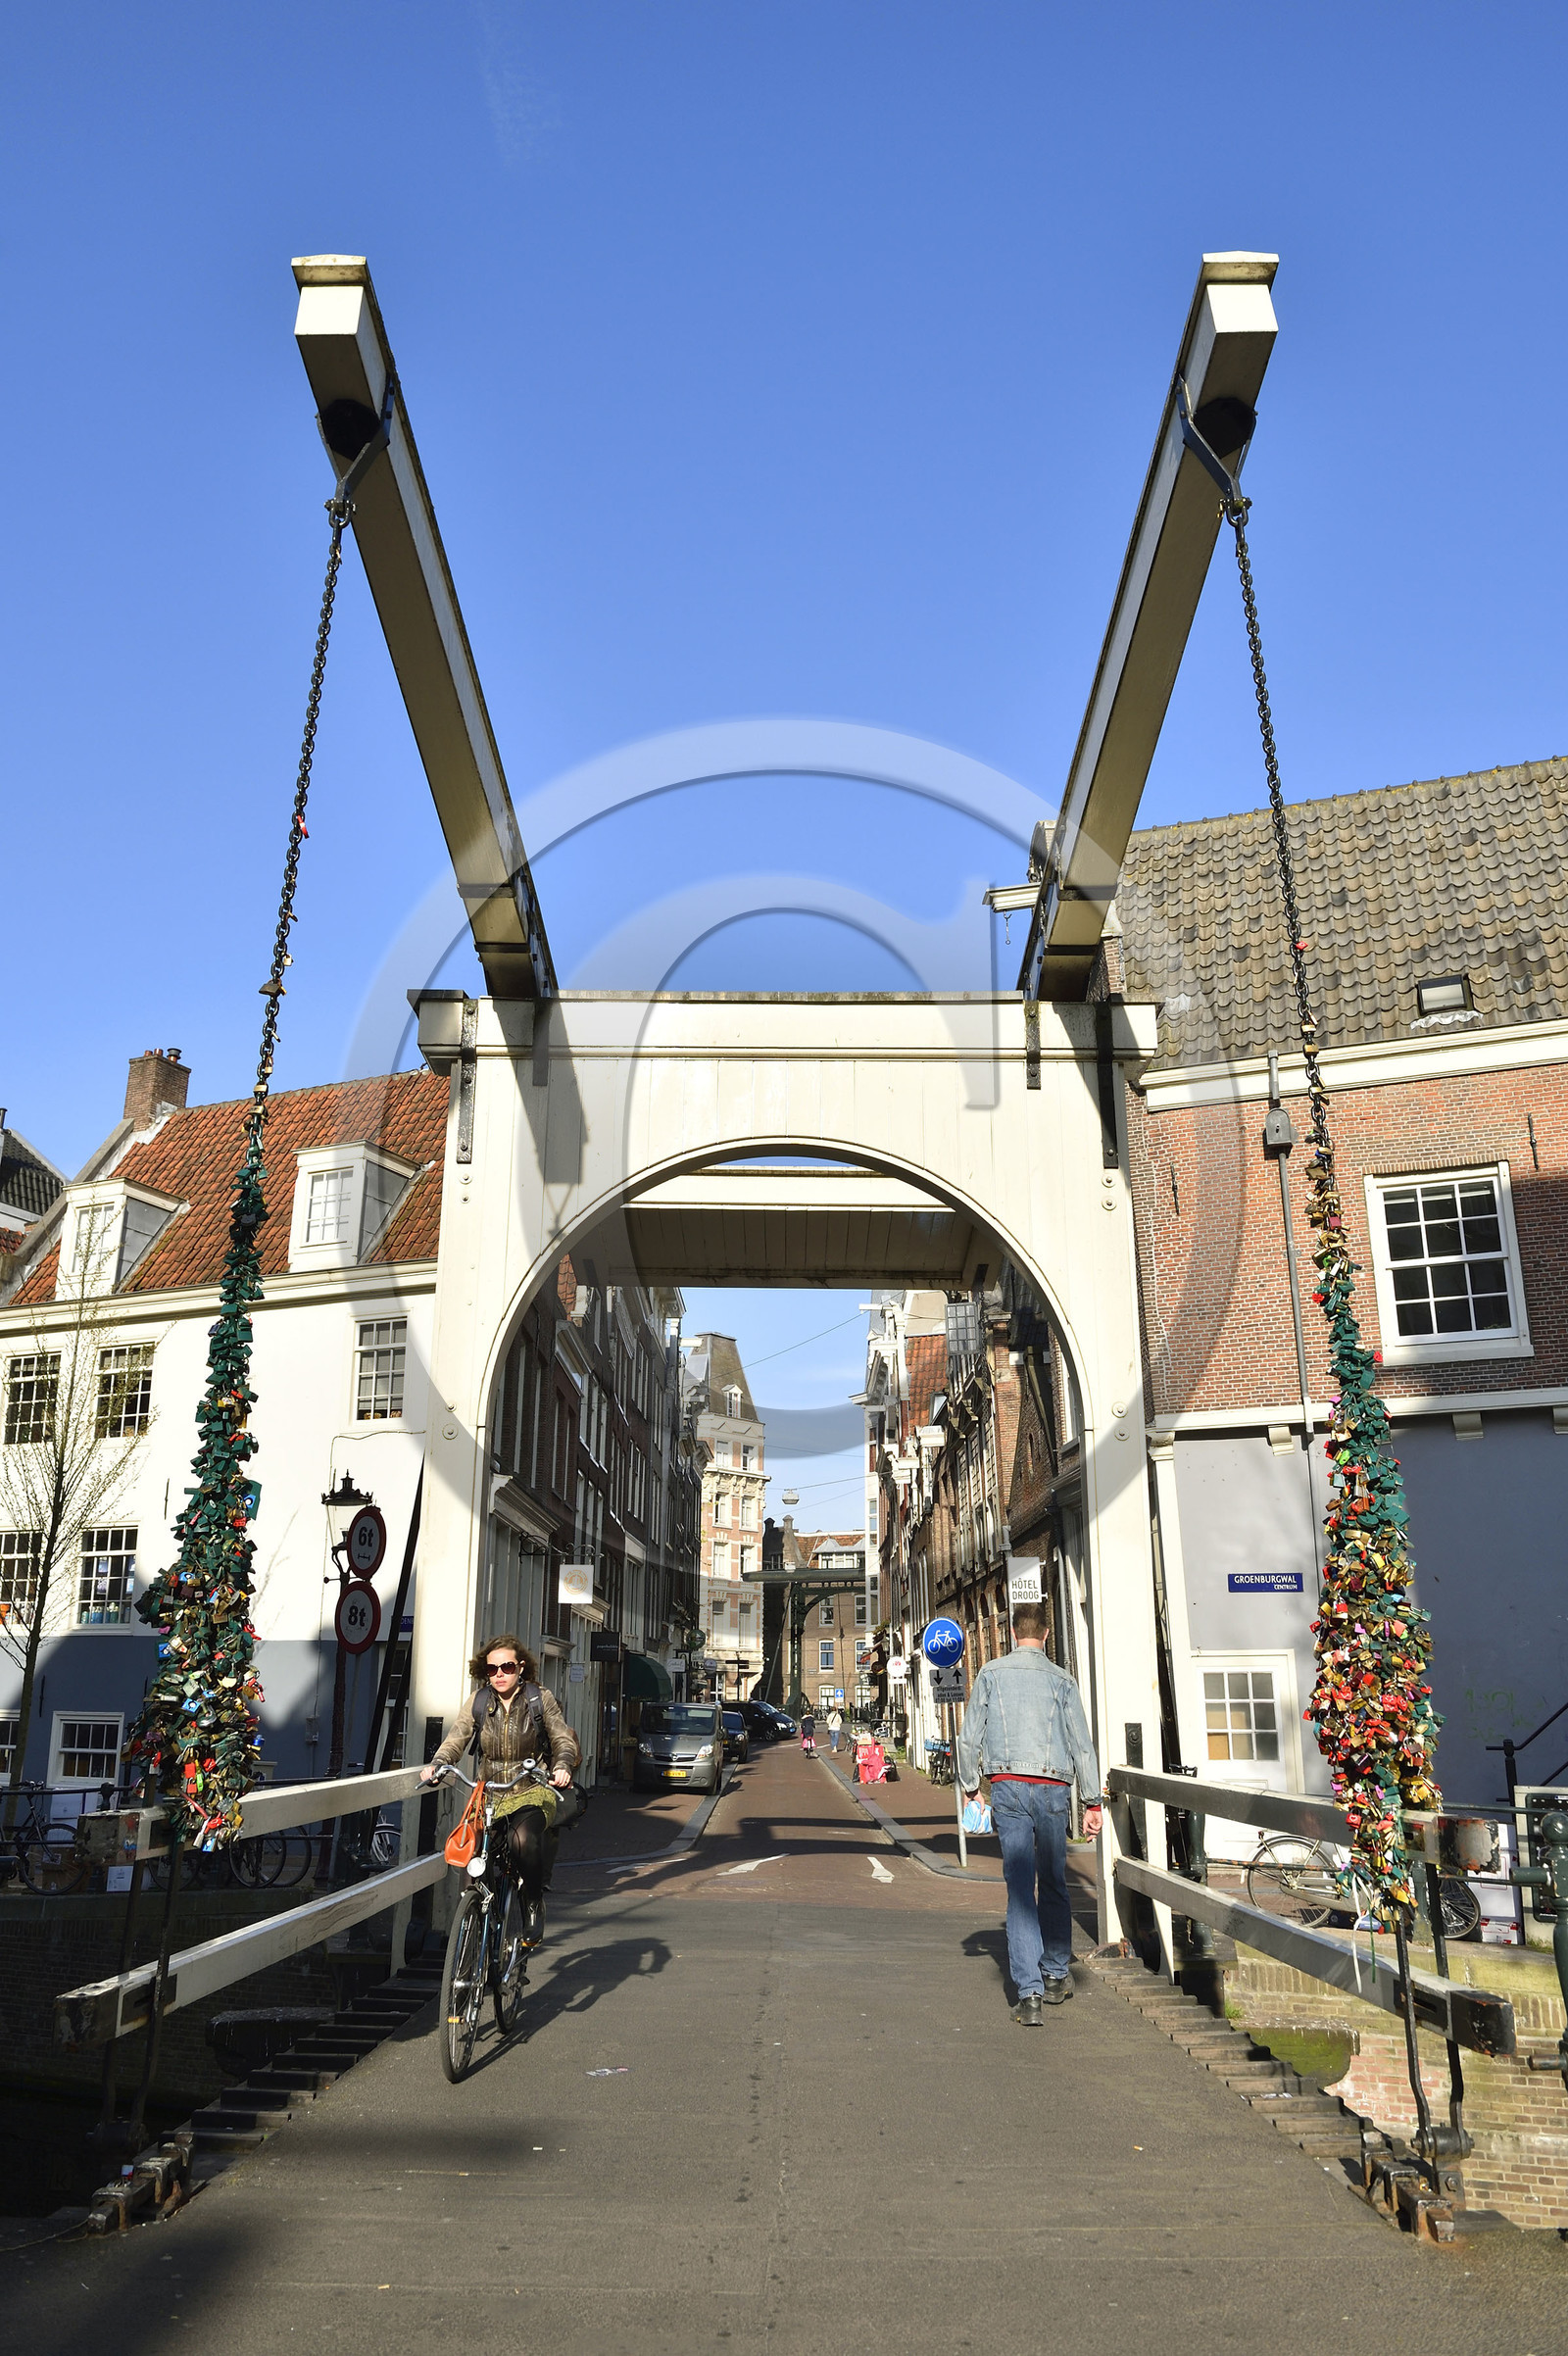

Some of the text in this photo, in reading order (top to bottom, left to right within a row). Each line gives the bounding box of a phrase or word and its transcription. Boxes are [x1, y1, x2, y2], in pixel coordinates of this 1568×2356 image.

[358, 1526, 373, 1547] 6t
[1011, 1577, 1039, 1590] HÔTEL
[1234, 1575, 1297, 1584] GROENBURGWAL
[1011, 1591, 1040, 1600] DROOG
[348, 1605, 367, 1627] 8t
